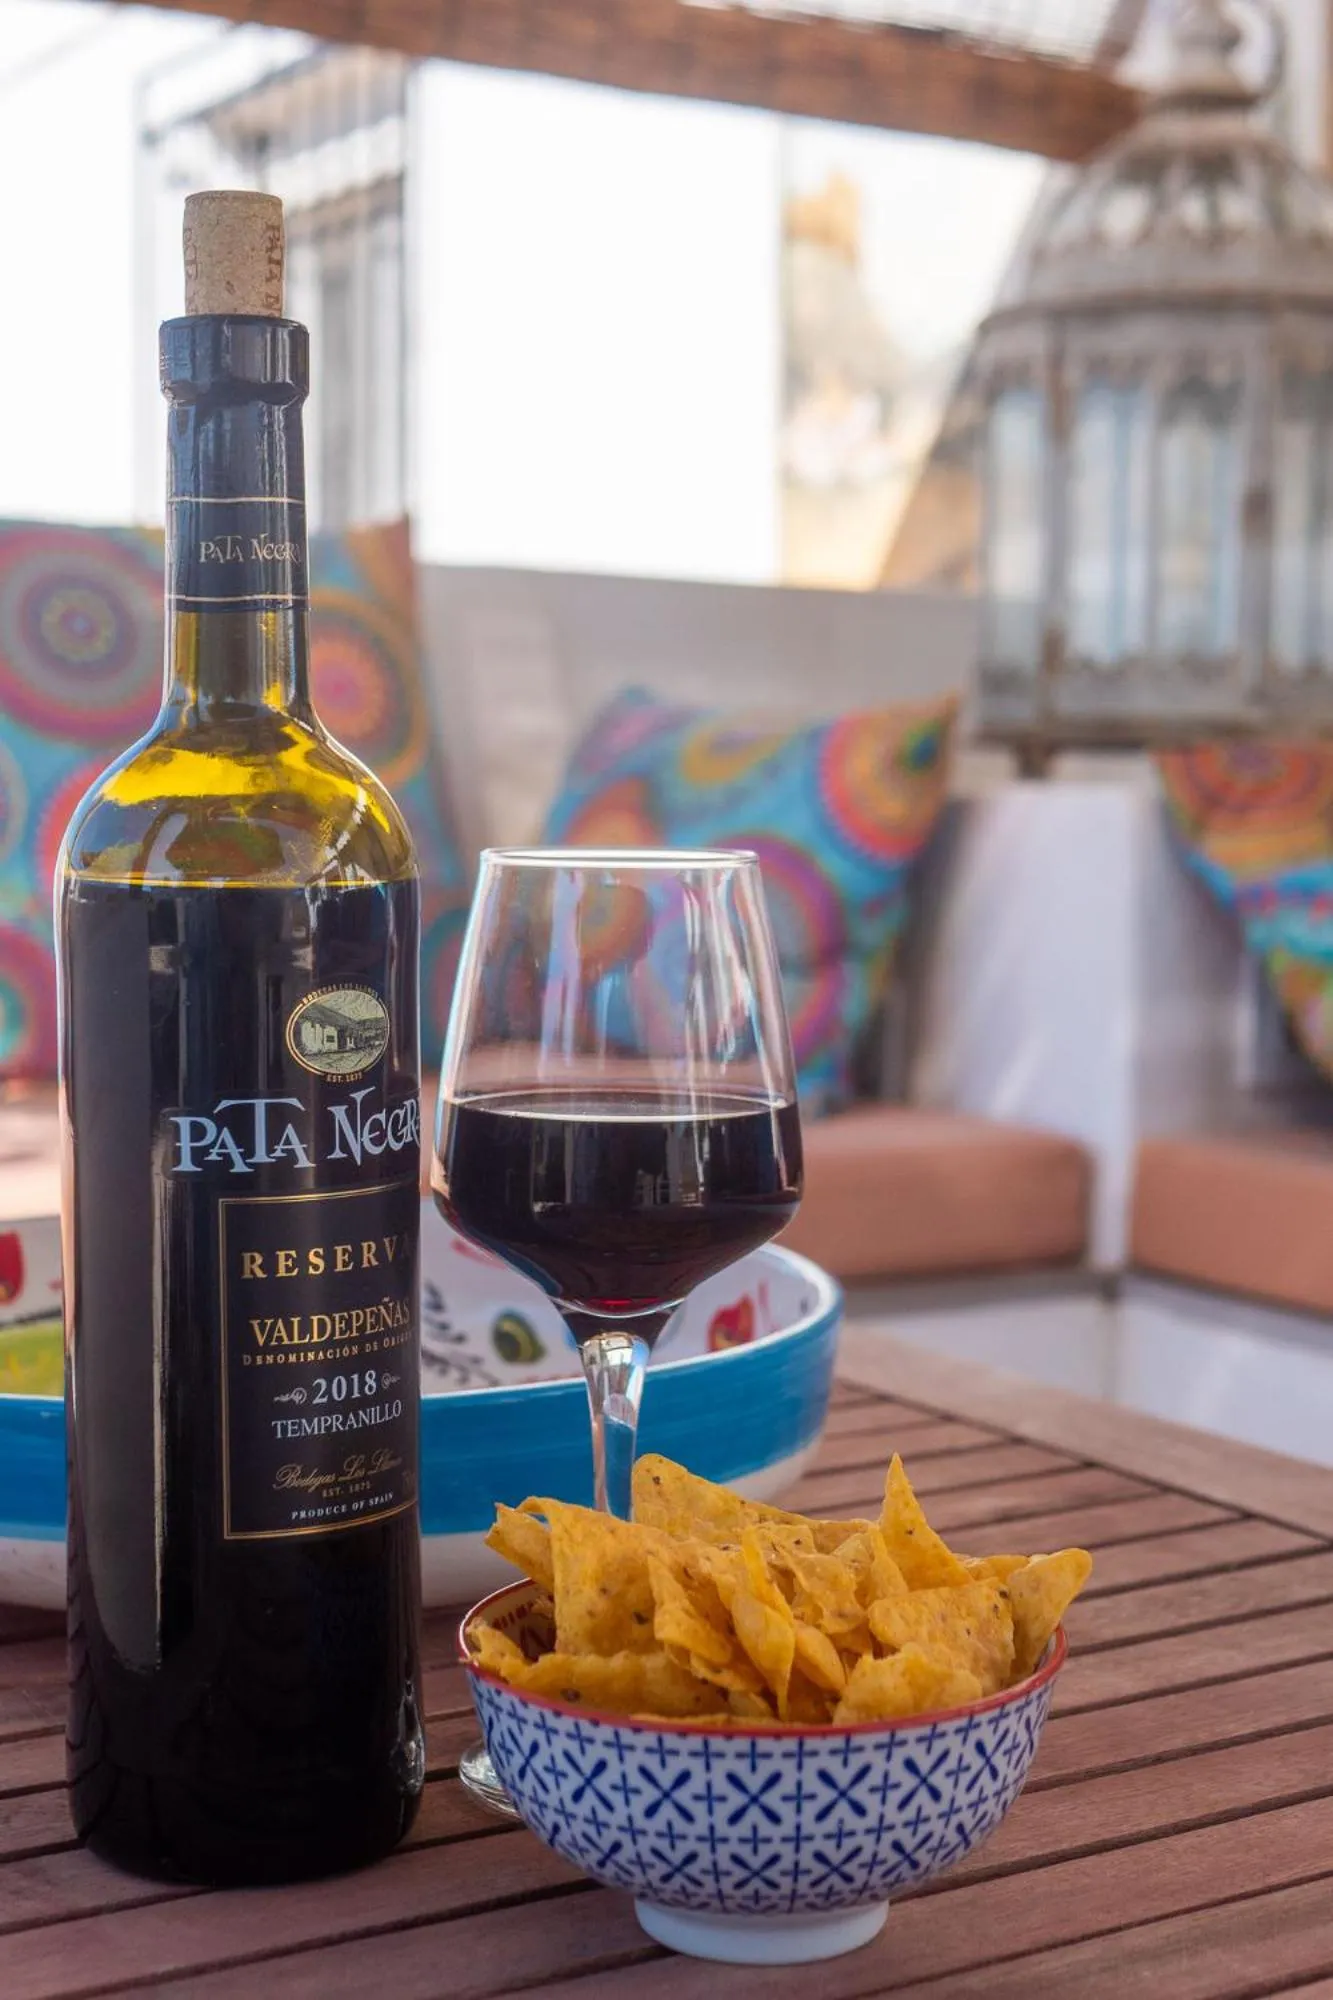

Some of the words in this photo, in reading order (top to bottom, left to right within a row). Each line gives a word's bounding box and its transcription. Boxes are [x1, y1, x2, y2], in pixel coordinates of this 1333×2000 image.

[199, 535, 244, 563] PATA
[170, 1098, 316, 1173] PATA
[326, 1086, 420, 1167] NEGR
[250, 1296, 410, 1347] VALDEPEÑAS
[243, 1344, 358, 1366] DENOMINACIÓN
[312, 1370, 377, 1404] 2018
[272, 1400, 401, 1438] TEMPRANILLO
[291, 1503, 347, 1520] PRODUCE
[352, 1500, 365, 1511] OF
[369, 1491, 394, 1507] SPAIN
